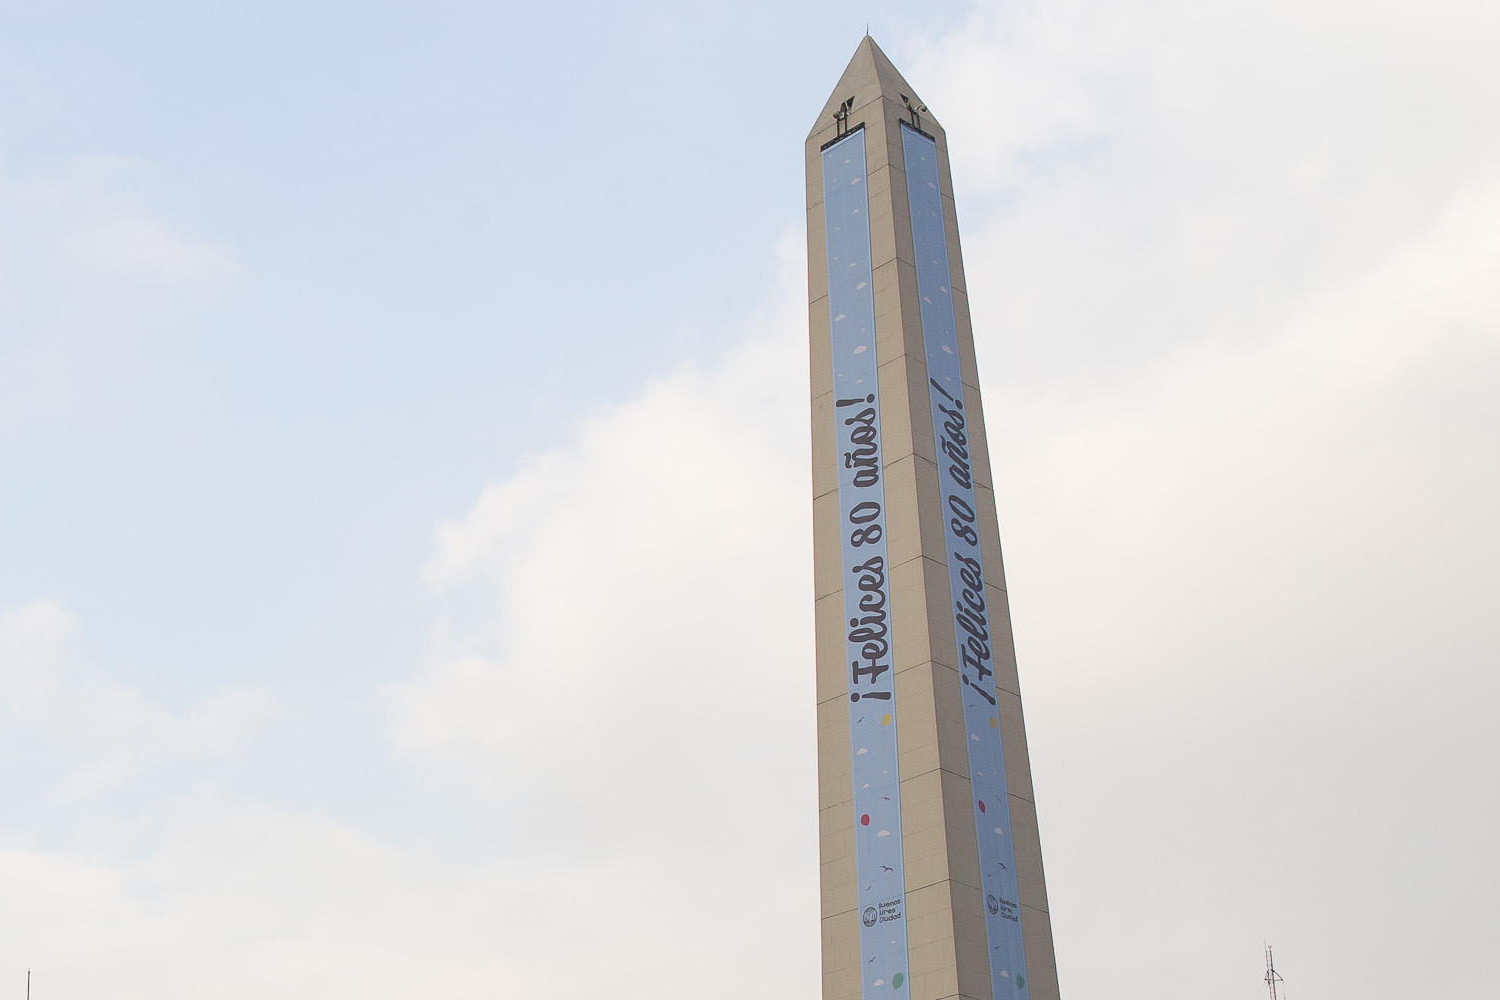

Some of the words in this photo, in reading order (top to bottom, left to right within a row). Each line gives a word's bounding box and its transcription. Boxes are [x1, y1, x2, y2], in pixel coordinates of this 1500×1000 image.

[836, 394, 878, 487] años!
[930, 377, 972, 489] años!
[850, 501, 882, 547] 80
[948, 495, 978, 546] 80
